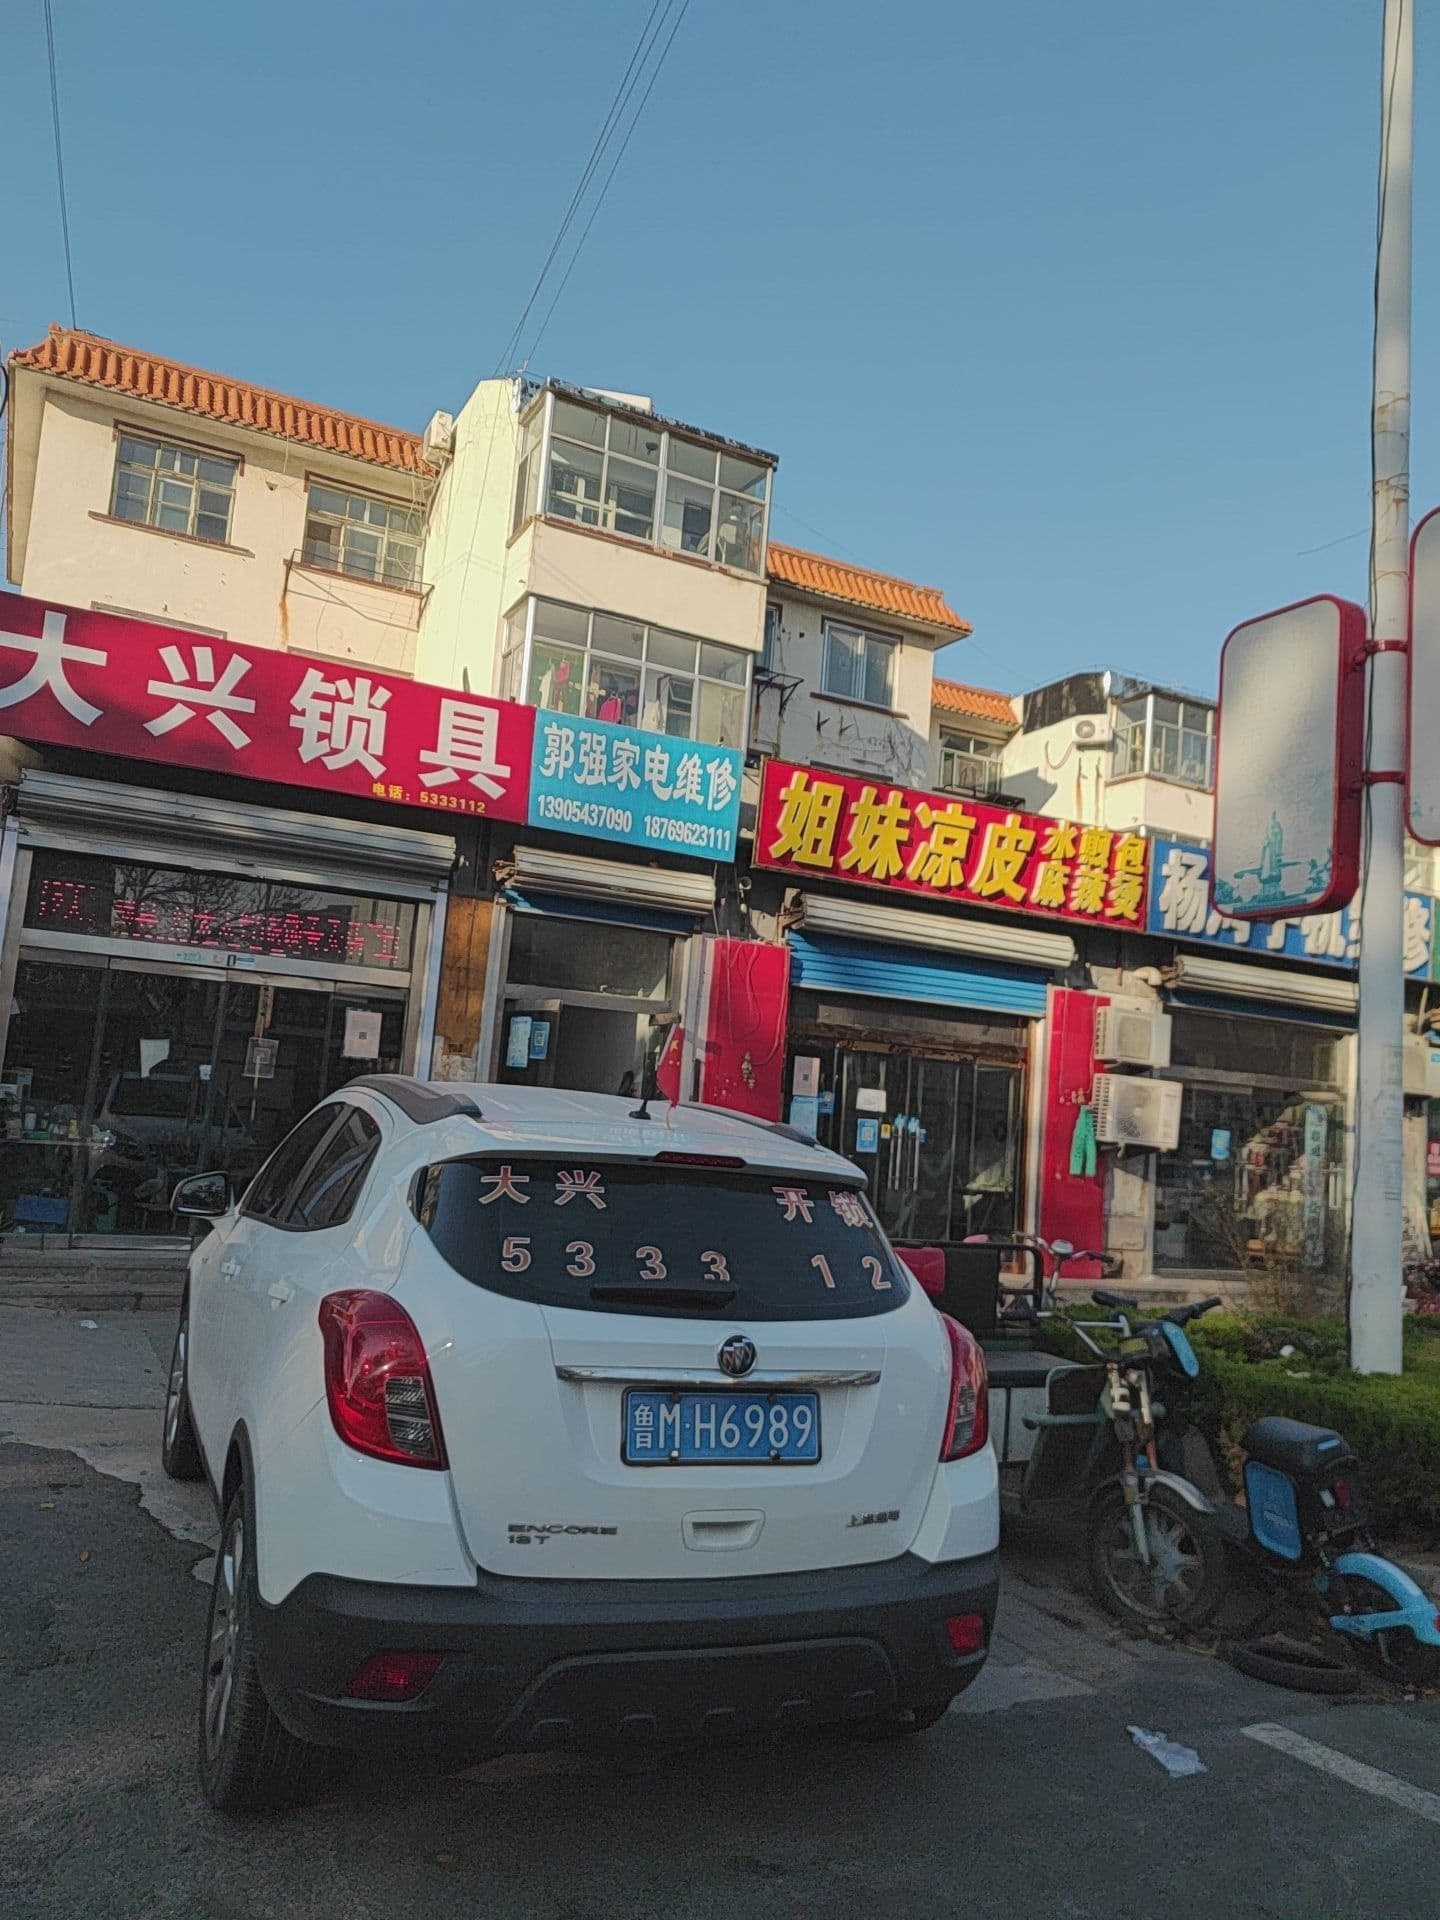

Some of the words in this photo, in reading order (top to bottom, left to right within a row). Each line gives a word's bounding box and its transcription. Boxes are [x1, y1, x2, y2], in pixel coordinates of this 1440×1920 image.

[0, 609, 512, 801] 大兴锁具
[538, 721, 738, 811] 郭强家电维修
[537, 794, 633, 833] 13905437090
[644, 814, 731, 851] 18769623111
[768, 770, 1036, 901] 姐妹凉皮
[1040, 820, 1146, 875] 水煎包
[1029, 860, 1144, 920] 麻辣烫
[508, 1523, 618, 1536] ENCORE
